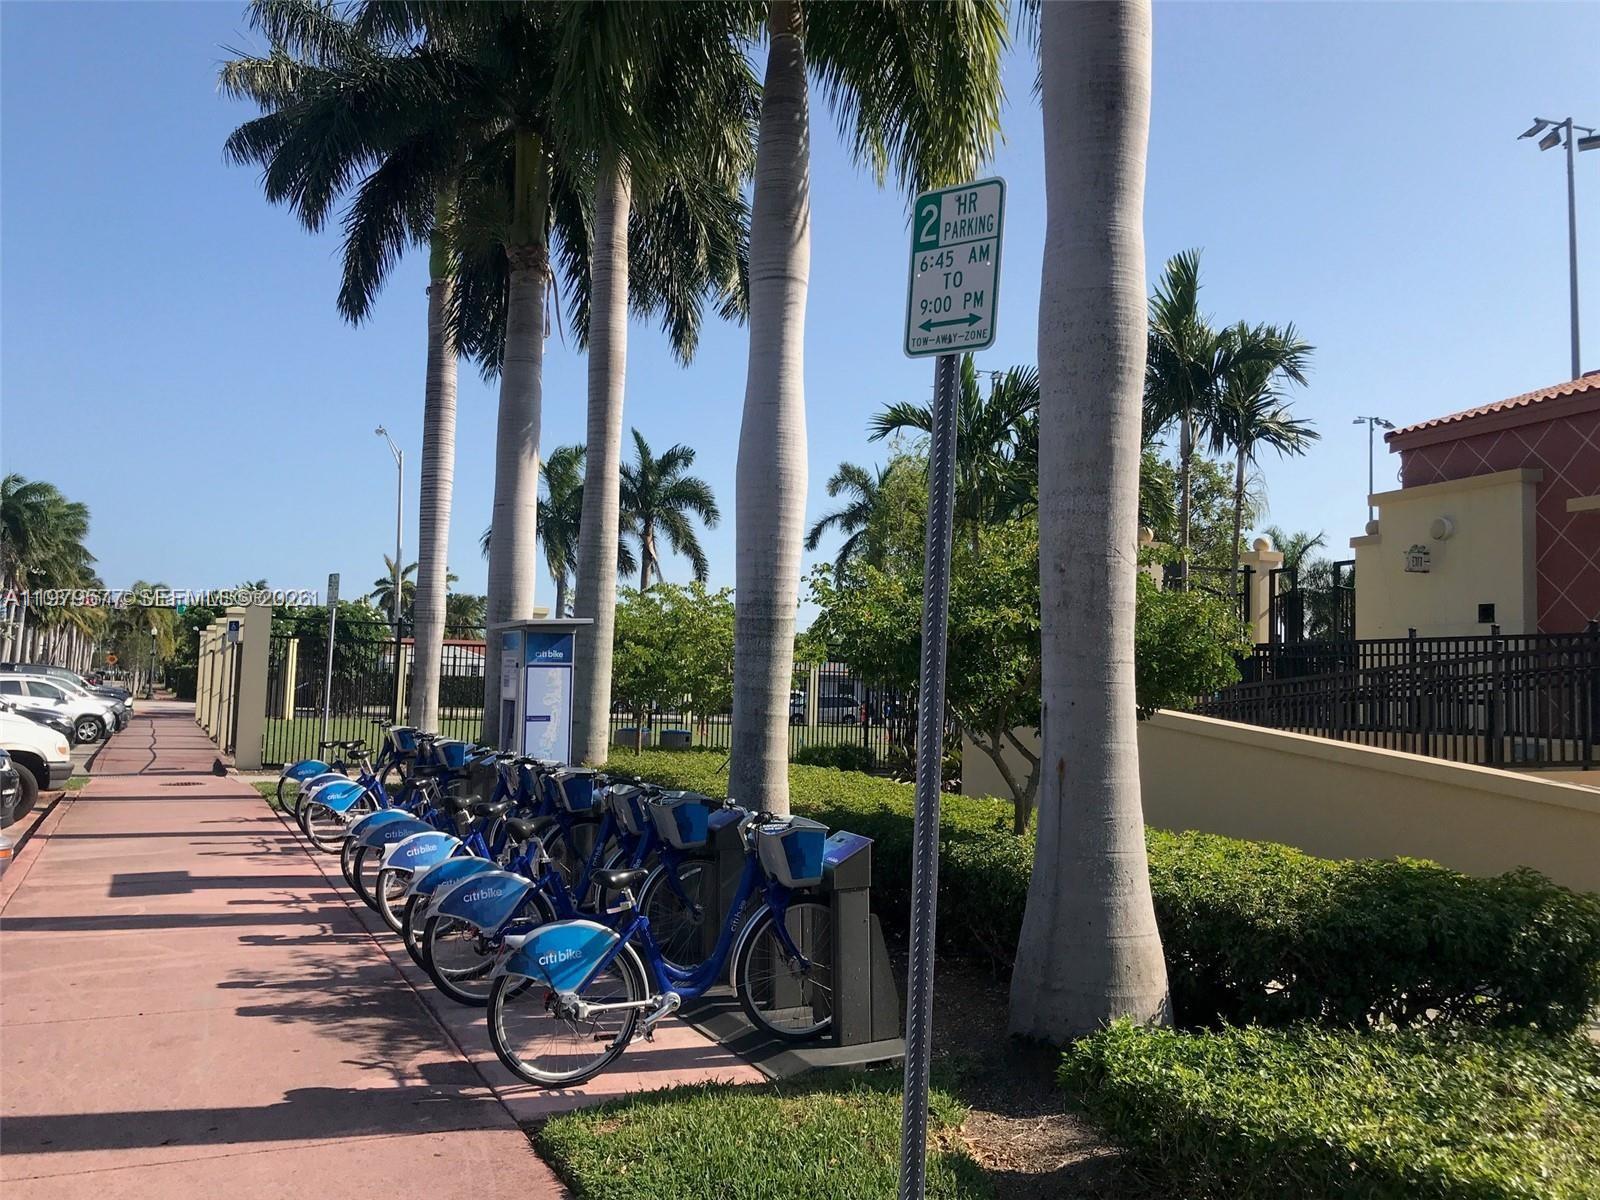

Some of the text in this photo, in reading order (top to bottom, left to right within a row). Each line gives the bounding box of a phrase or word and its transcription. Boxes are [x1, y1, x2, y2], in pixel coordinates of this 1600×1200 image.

[956, 192, 978, 216] HR
[919, 203, 939, 243] 2
[943, 213, 994, 241] PARKING
[920, 244, 990, 273] 6:45 AM
[943, 271, 963, 290] TO
[920, 290, 984, 316] 9:00 PM
[911, 328, 988, 348] TOW-AWAY-ZONE
[479, 887, 503, 901] bike
[558, 948, 582, 963] bike
